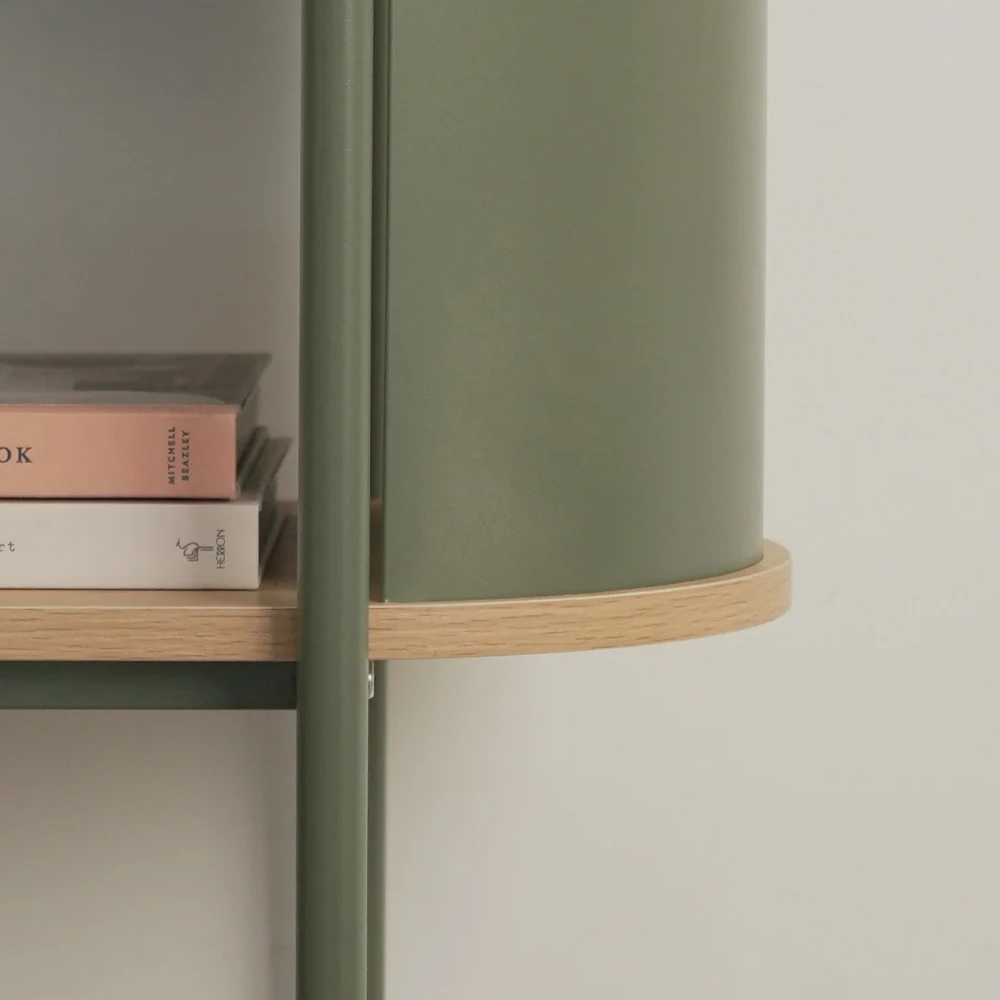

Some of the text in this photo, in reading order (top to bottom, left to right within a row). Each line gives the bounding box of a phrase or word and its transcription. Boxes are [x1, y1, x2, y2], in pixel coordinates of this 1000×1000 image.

[167, 426, 176, 485] MITCHELL
[181, 430, 190, 482] BEAZLEY
[216, 529, 226, 569] HERRON
